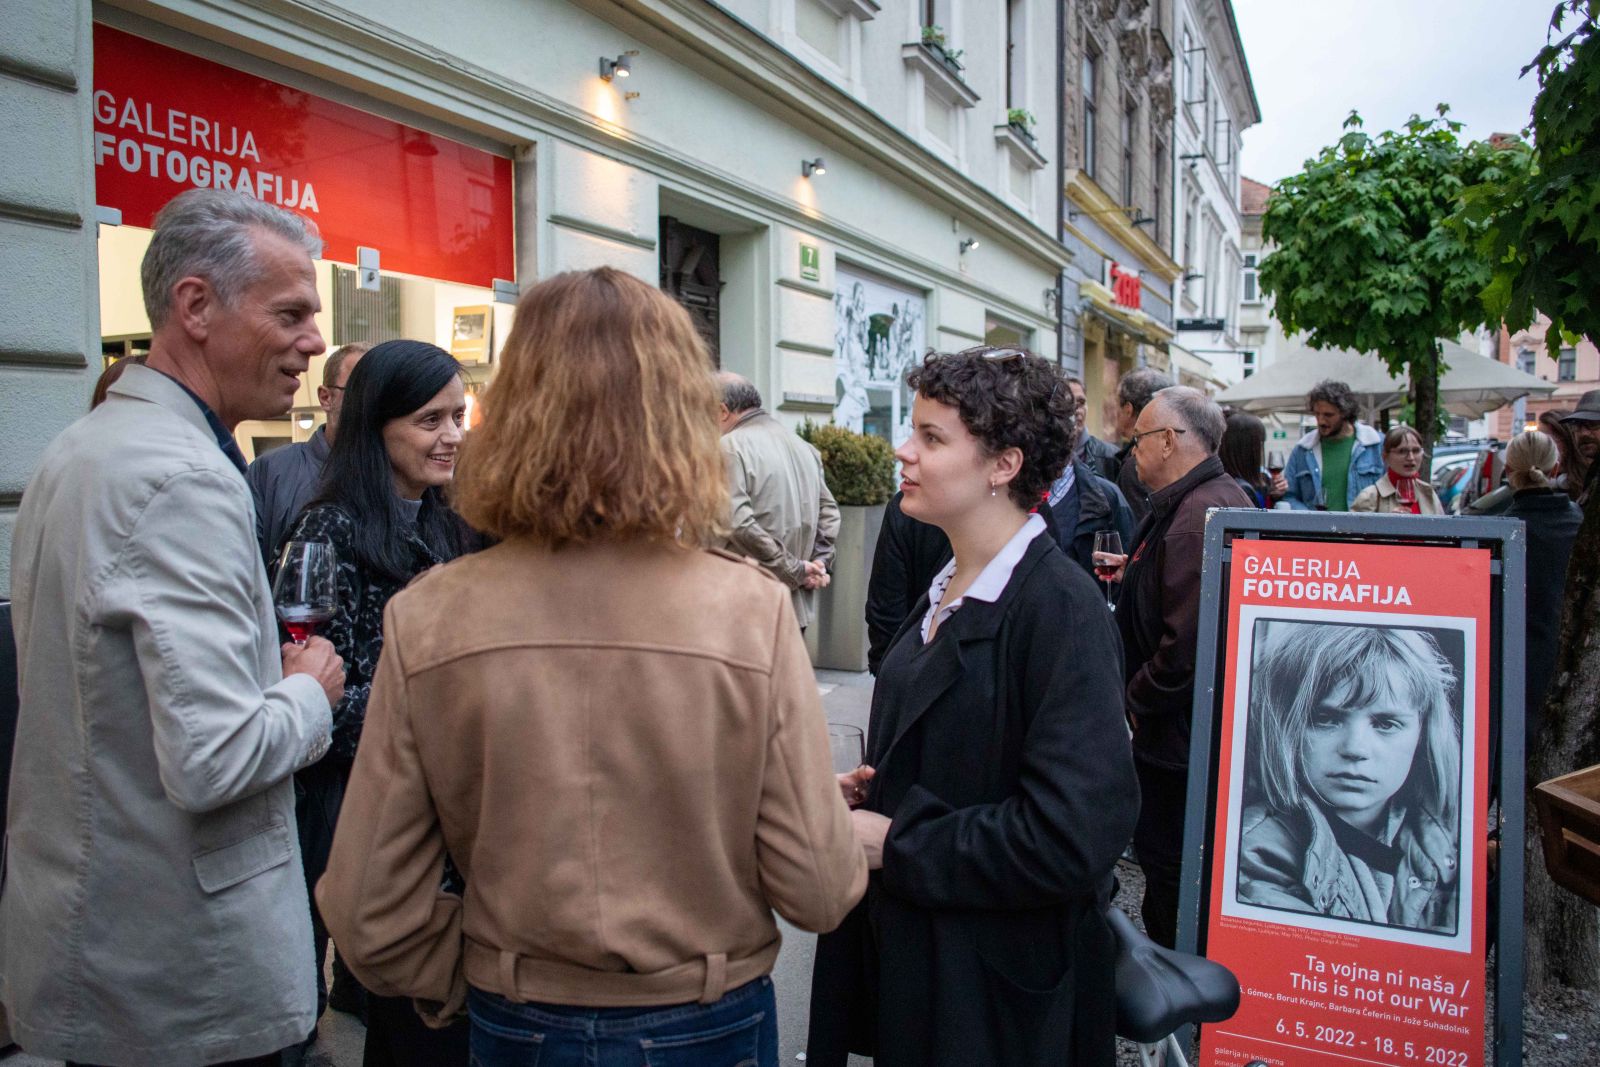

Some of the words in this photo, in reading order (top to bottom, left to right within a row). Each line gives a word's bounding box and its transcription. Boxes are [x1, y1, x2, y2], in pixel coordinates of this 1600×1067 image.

[93, 89, 261, 163] GALERIJA
[94, 131, 320, 213] FOTOGRAFIJA
[1244, 556, 1361, 579] GALERIJA
[1243, 578, 1412, 606] FOTOGRAFIJA
[1290, 972, 1328, 993] This
[1333, 979, 1349, 997] is
[1354, 986, 1384, 1004] not
[1390, 993, 1423, 1010] our
[1429, 995, 1470, 1018] War
[1305, 954, 1325, 973] Ta
[1331, 962, 1380, 982] vojna
[1386, 969, 1403, 986] ni
[1409, 975, 1455, 995] naša
[1460, 979, 1471, 998] /
[1247, 987, 1275, 1000] Gómez,
[1276, 993, 1298, 1004] Borut
[1299, 998, 1327, 1011] Krajnc,
[1329, 1002, 1361, 1015] Barbara
[1362, 1006, 1391, 1021] Čeferin
[1393, 1013, 1401, 1022] in
[1403, 1015, 1422, 1027] Jože
[1423, 1019, 1470, 1035] Suhadolnik
[1215, 1047, 1241, 1058] galerija
[1243, 1051, 1249, 1059] in
[1276, 1018, 1290, 1035] 6.
[1295, 1021, 1309, 1039] 5.
[1315, 1025, 1355, 1047] 2022
[1374, 1036, 1398, 1056] 18.
[1404, 1042, 1419, 1060] 5.
[1425, 1046, 1469, 1067] 2022
